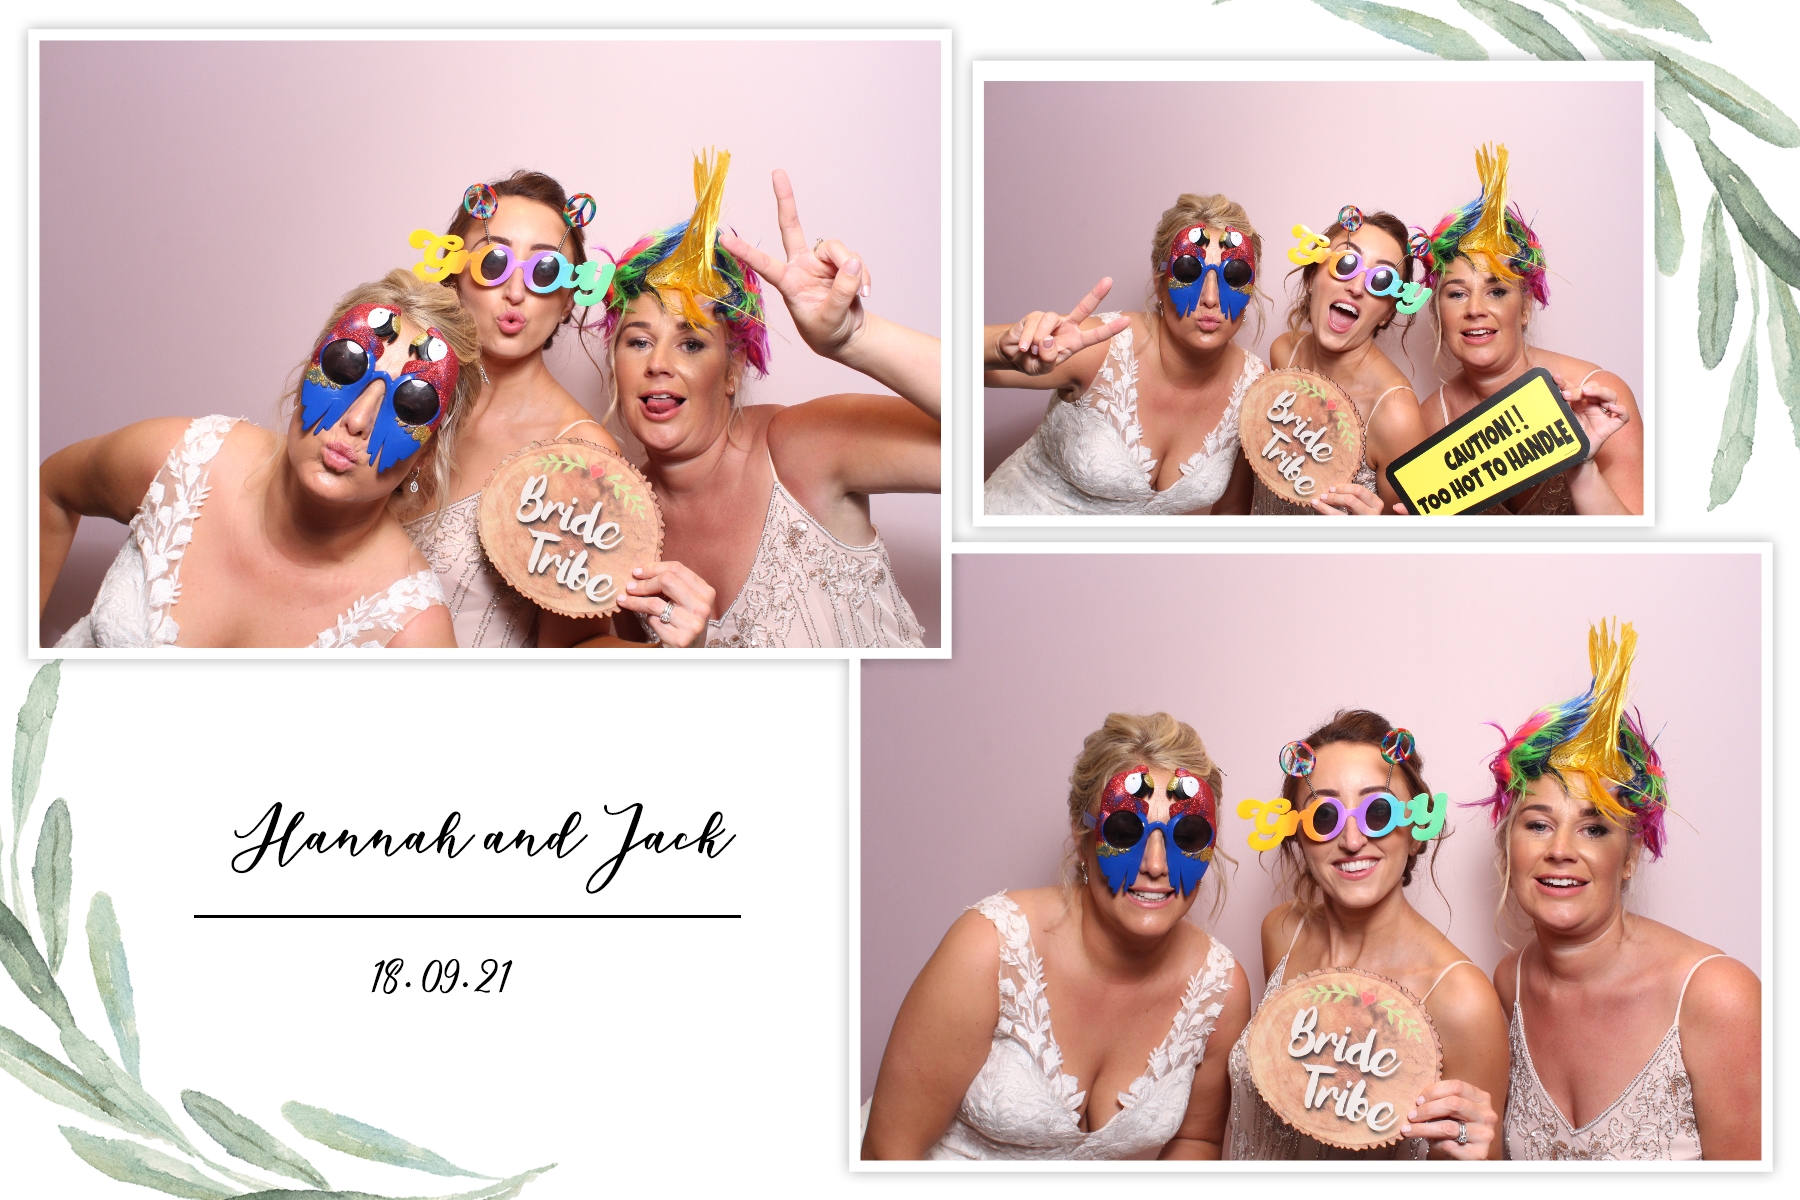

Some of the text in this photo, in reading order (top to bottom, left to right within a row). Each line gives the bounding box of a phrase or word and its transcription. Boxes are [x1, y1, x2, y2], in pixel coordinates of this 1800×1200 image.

[1261, 425, 1316, 495] Tribe
[1266, 389, 1334, 462] Bride
[1444, 404, 1529, 470] CAUTION!!
[1417, 418, 1575, 515] TOO HOT TO HANDLE
[516, 474, 624, 550] Bride
[527, 527, 618, 601] Tribe
[1288, 1006, 1402, 1077] Bride
[1302, 1062, 1399, 1131] Tribe
